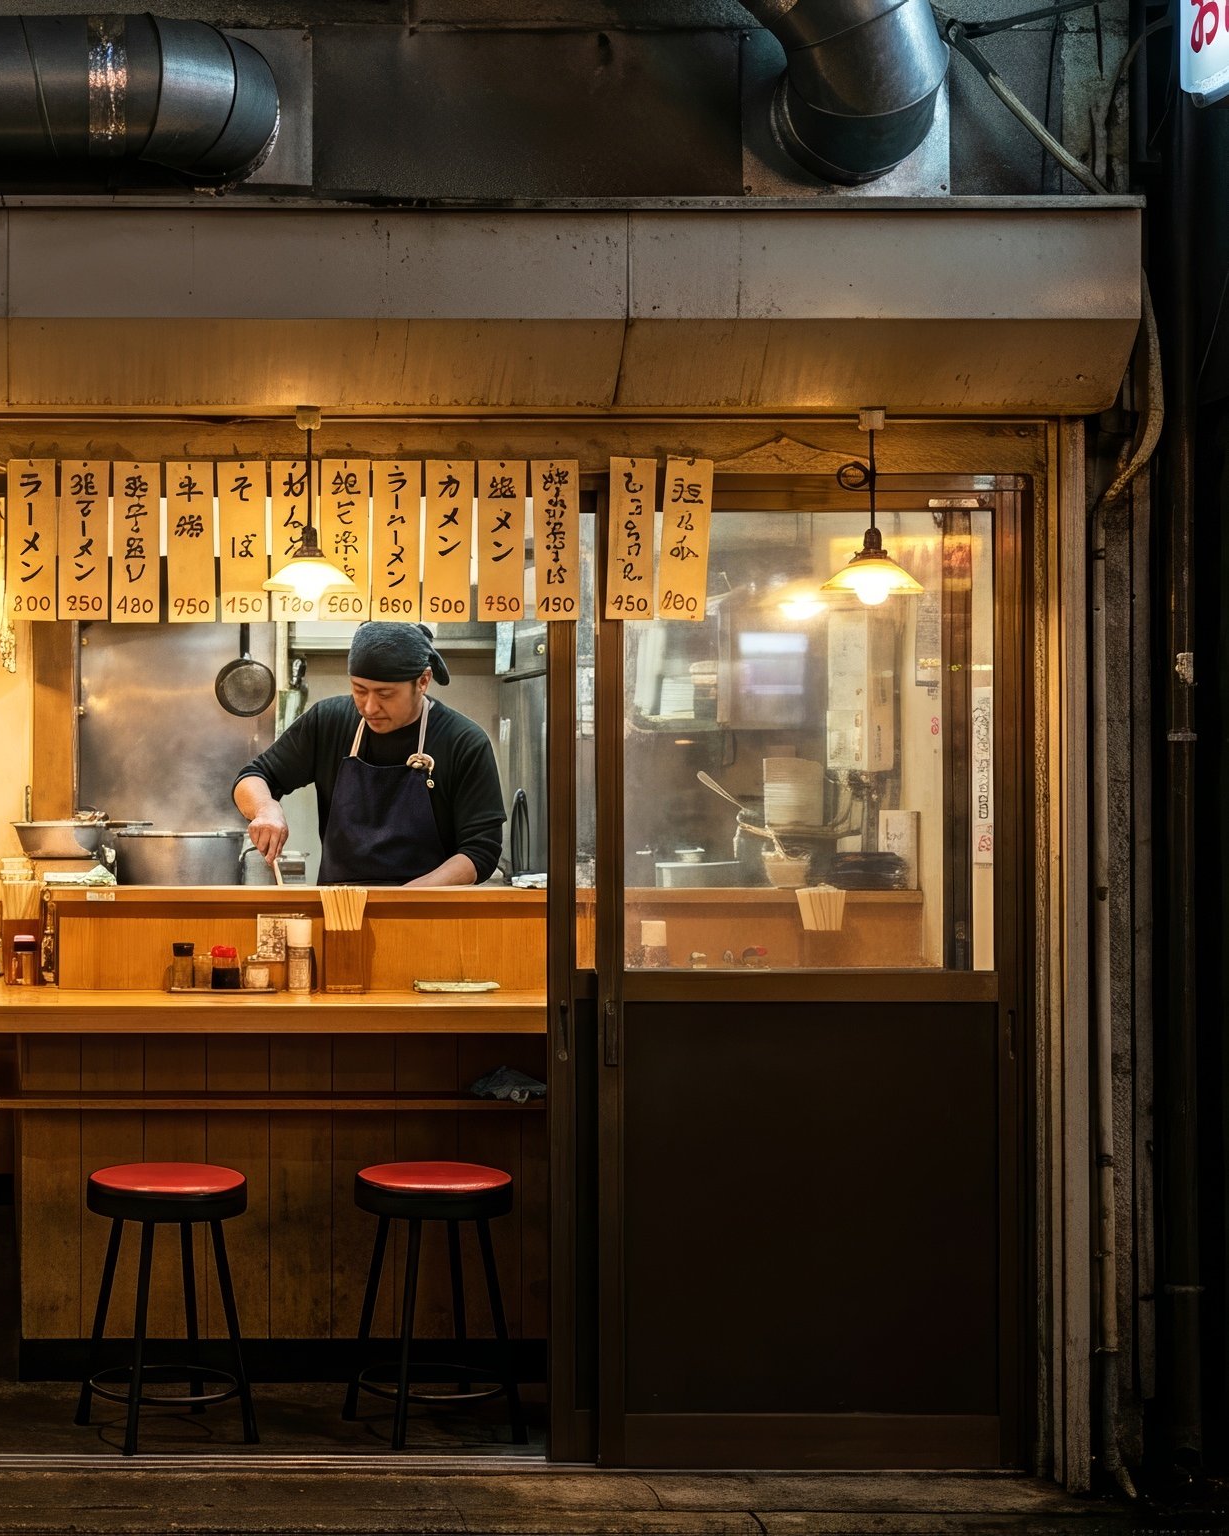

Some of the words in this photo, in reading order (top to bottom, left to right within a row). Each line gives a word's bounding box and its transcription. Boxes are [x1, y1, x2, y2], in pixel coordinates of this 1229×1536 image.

[231, 476, 256, 559] そば
[20, 473, 44, 583] ラーメン
[13, 594, 52, 612] 800
[116, 595, 154, 614] 480
[173, 597, 210, 616] 950
[225, 597, 262, 613] 150
[429, 596, 465, 614] 500
